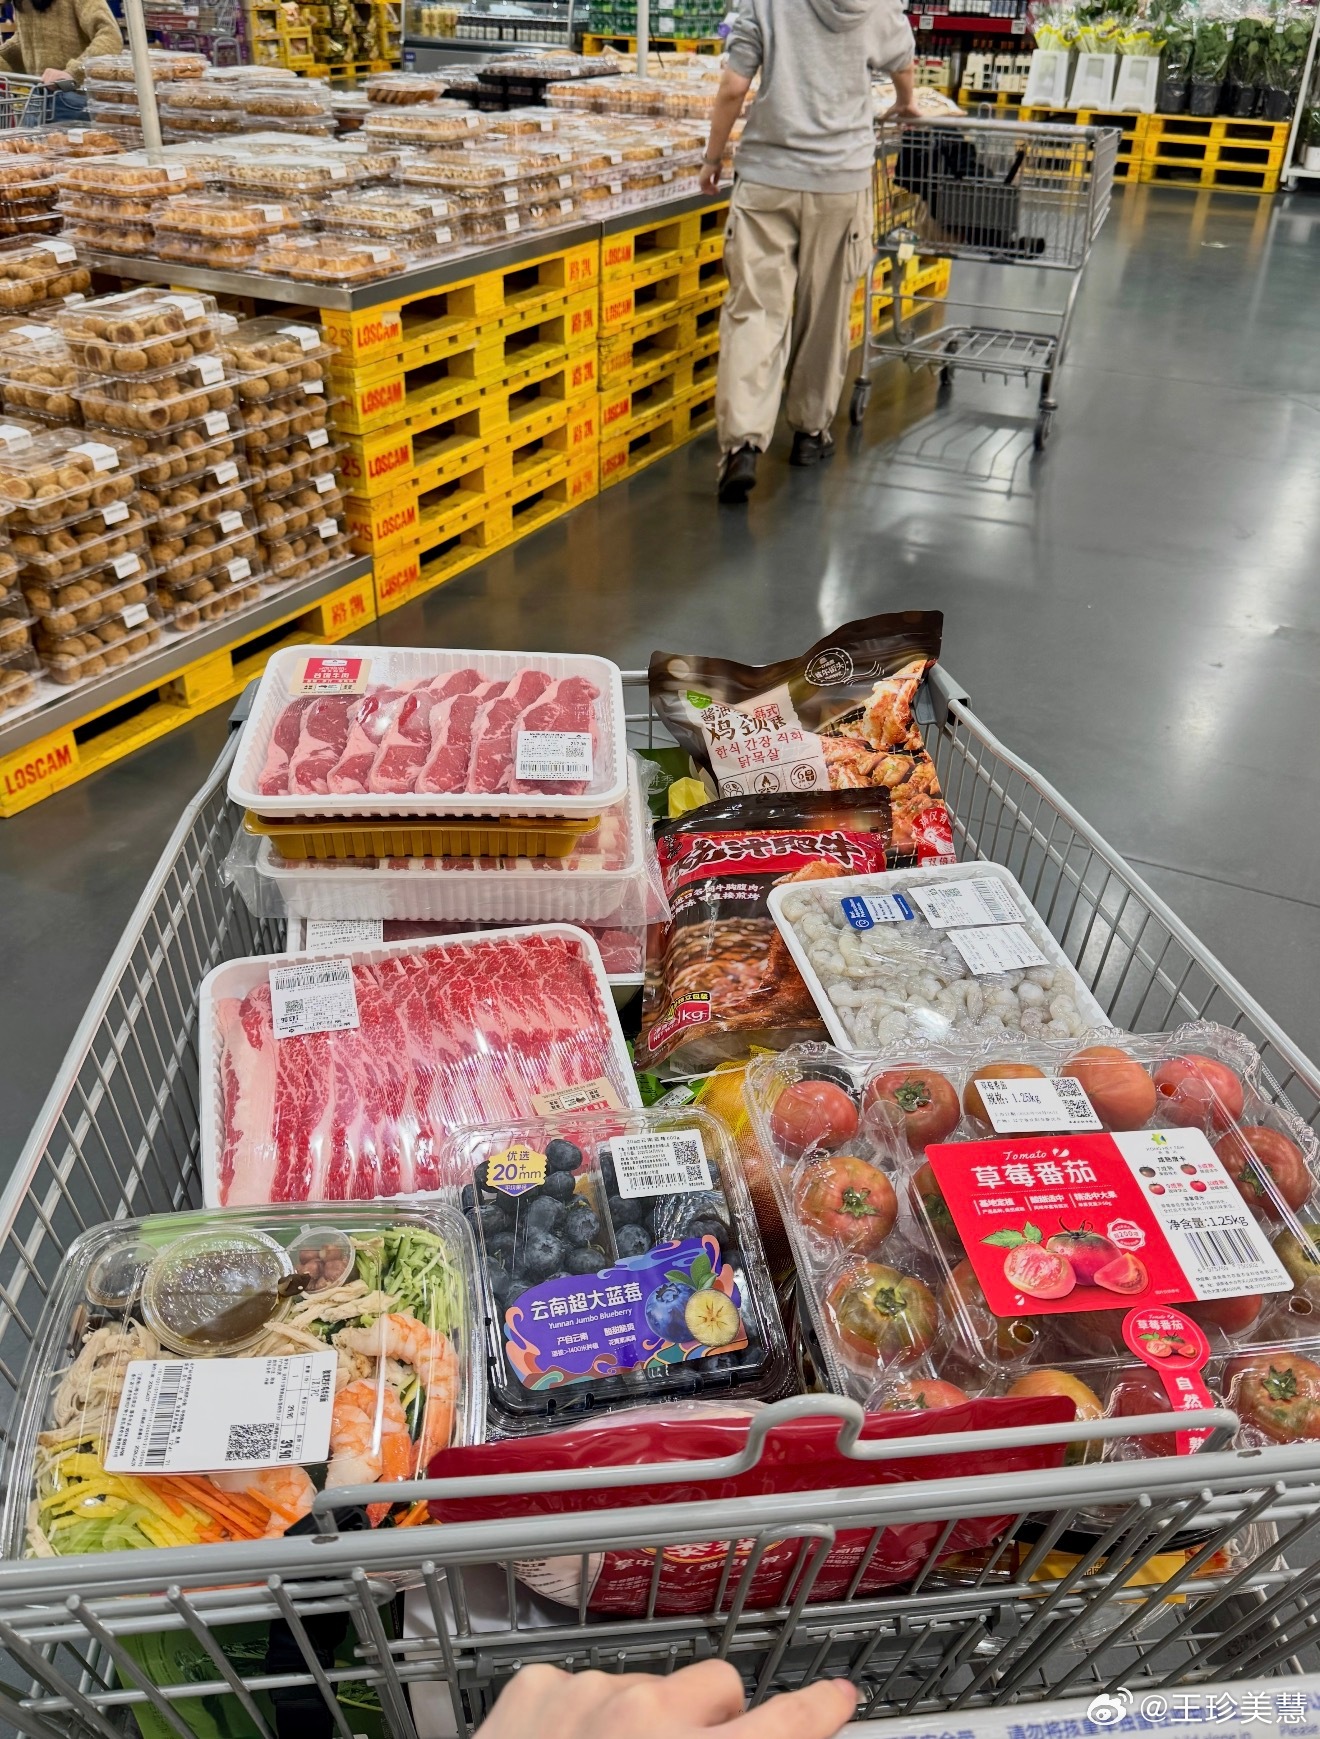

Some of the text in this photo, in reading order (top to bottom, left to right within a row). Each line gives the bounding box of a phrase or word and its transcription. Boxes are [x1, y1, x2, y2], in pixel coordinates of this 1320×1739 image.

[605, 245, 631, 266] LOSCAM
[605, 298, 632, 322] LOSCAM
[361, 382, 402, 416] LOSCAM
[603, 398, 629, 425] LOSCAM
[369, 445, 409, 479] LOSCAM
[377, 506, 416, 540] LOSCAM
[380, 563, 418, 599] LOSCAM
[715, 729, 804, 760] 한식 간장 직화
[4, 744, 72, 795] LOSCAM
[738, 748, 780, 769] 닭목살
[507, 1151, 530, 1161] 优选
[1002, 1150, 1047, 1161] Tomato
[971, 1160, 1098, 1189] 草莓番茄
[531, 1282, 642, 1321] 云南超大蓝莓
[549, 1308, 633, 1330] Yunnan Jumbo Blueberry
[1136, 1319, 1184, 1331] 草莓番茄
[557, 1332, 589, 1346] 产自云南
[279, 1439, 293, 1460] 39.90
